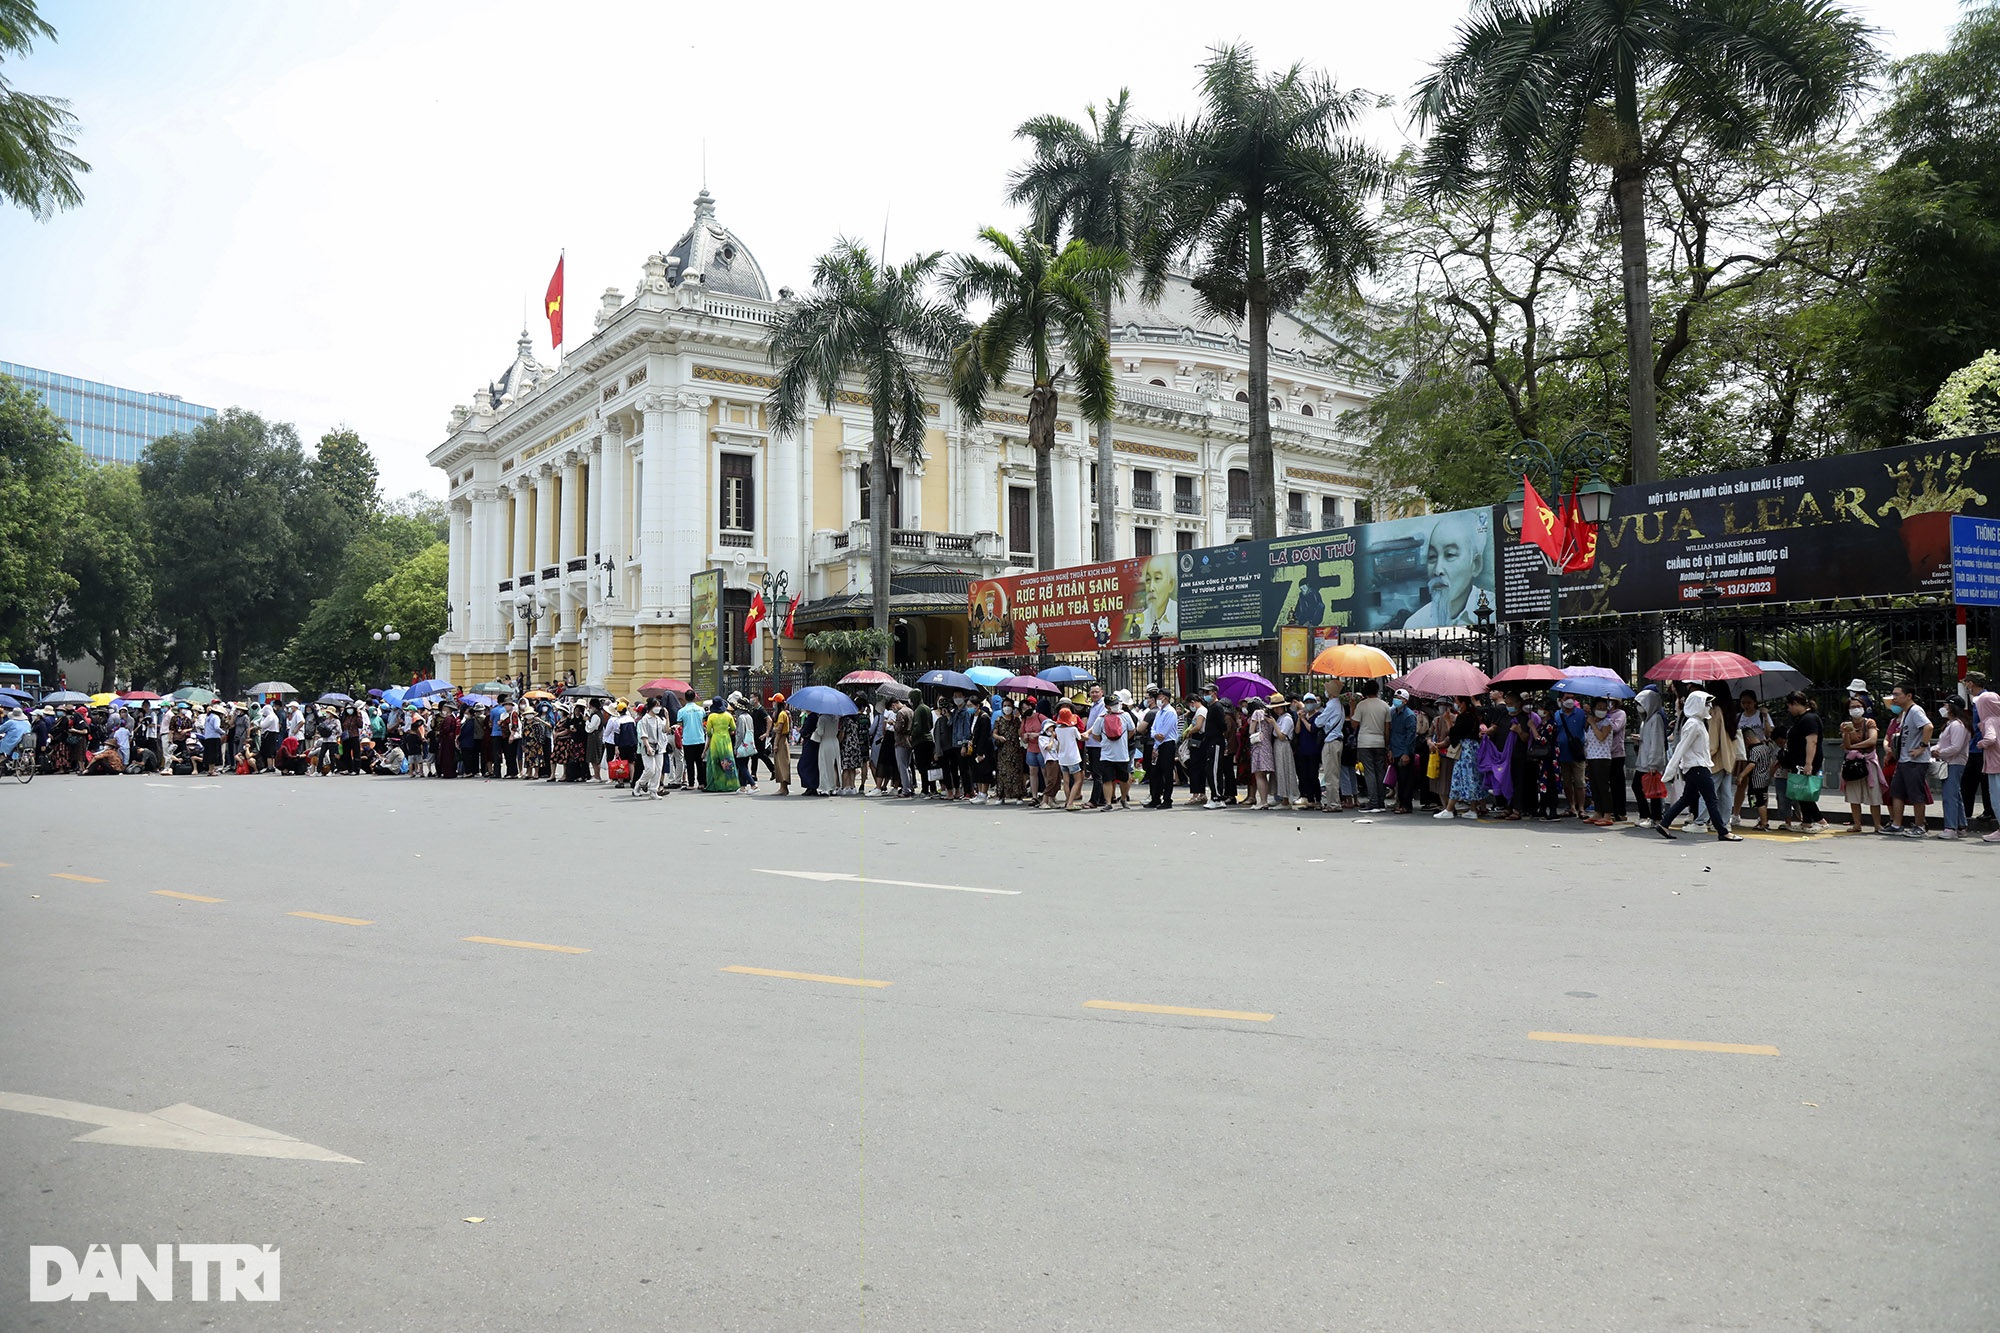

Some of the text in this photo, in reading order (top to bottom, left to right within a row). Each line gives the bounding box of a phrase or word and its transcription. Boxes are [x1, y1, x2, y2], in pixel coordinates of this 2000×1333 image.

[1649, 493, 1663, 506] MỘT
[1665, 491, 1678, 502] TÁC
[1702, 485, 1716, 498] MỚI
[1718, 482, 1733, 496] CỦA
[1734, 481, 1749, 494] SÂN
[1751, 478, 1771, 492] KHẤU
[1773, 476, 1781, 491] LỆ
[1783, 475, 1804, 488] NGỌC
[1603, 487, 1880, 548] VUA LEAR
[1975, 523, 1996, 541] THÔNG
[1686, 538, 1766, 551] WILLIAM SHAKESPEARES
[1269, 548, 1288, 565] LÁ
[1292, 546, 1321, 563] ĐƠN
[1692, 555, 1703, 567] CÓ
[1705, 554, 1713, 566] GÌ
[1714, 552, 1726, 565] THÌ
[1756, 549, 1778, 563] ĐƯỢC
[1780, 546, 1788, 560] GÌ
[1101, 566, 1116, 576] XUÂN
[1679, 572, 1704, 581] Nothing
[1720, 569, 1738, 578] come
[1740, 568, 1748, 577] of
[1748, 565, 1775, 575] nothing
[1016, 577, 1119, 605] RỰC RỠ XUÂN SANG
[1272, 559, 1355, 632] 72
[1727, 581, 1771, 595] 13/3/2023
[1012, 605, 1038, 622] TRỌN
[1042, 601, 1064, 618] NĂM
[1067, 596, 1089, 615] TOẢ
[1093, 595, 1123, 613] SÁNG
